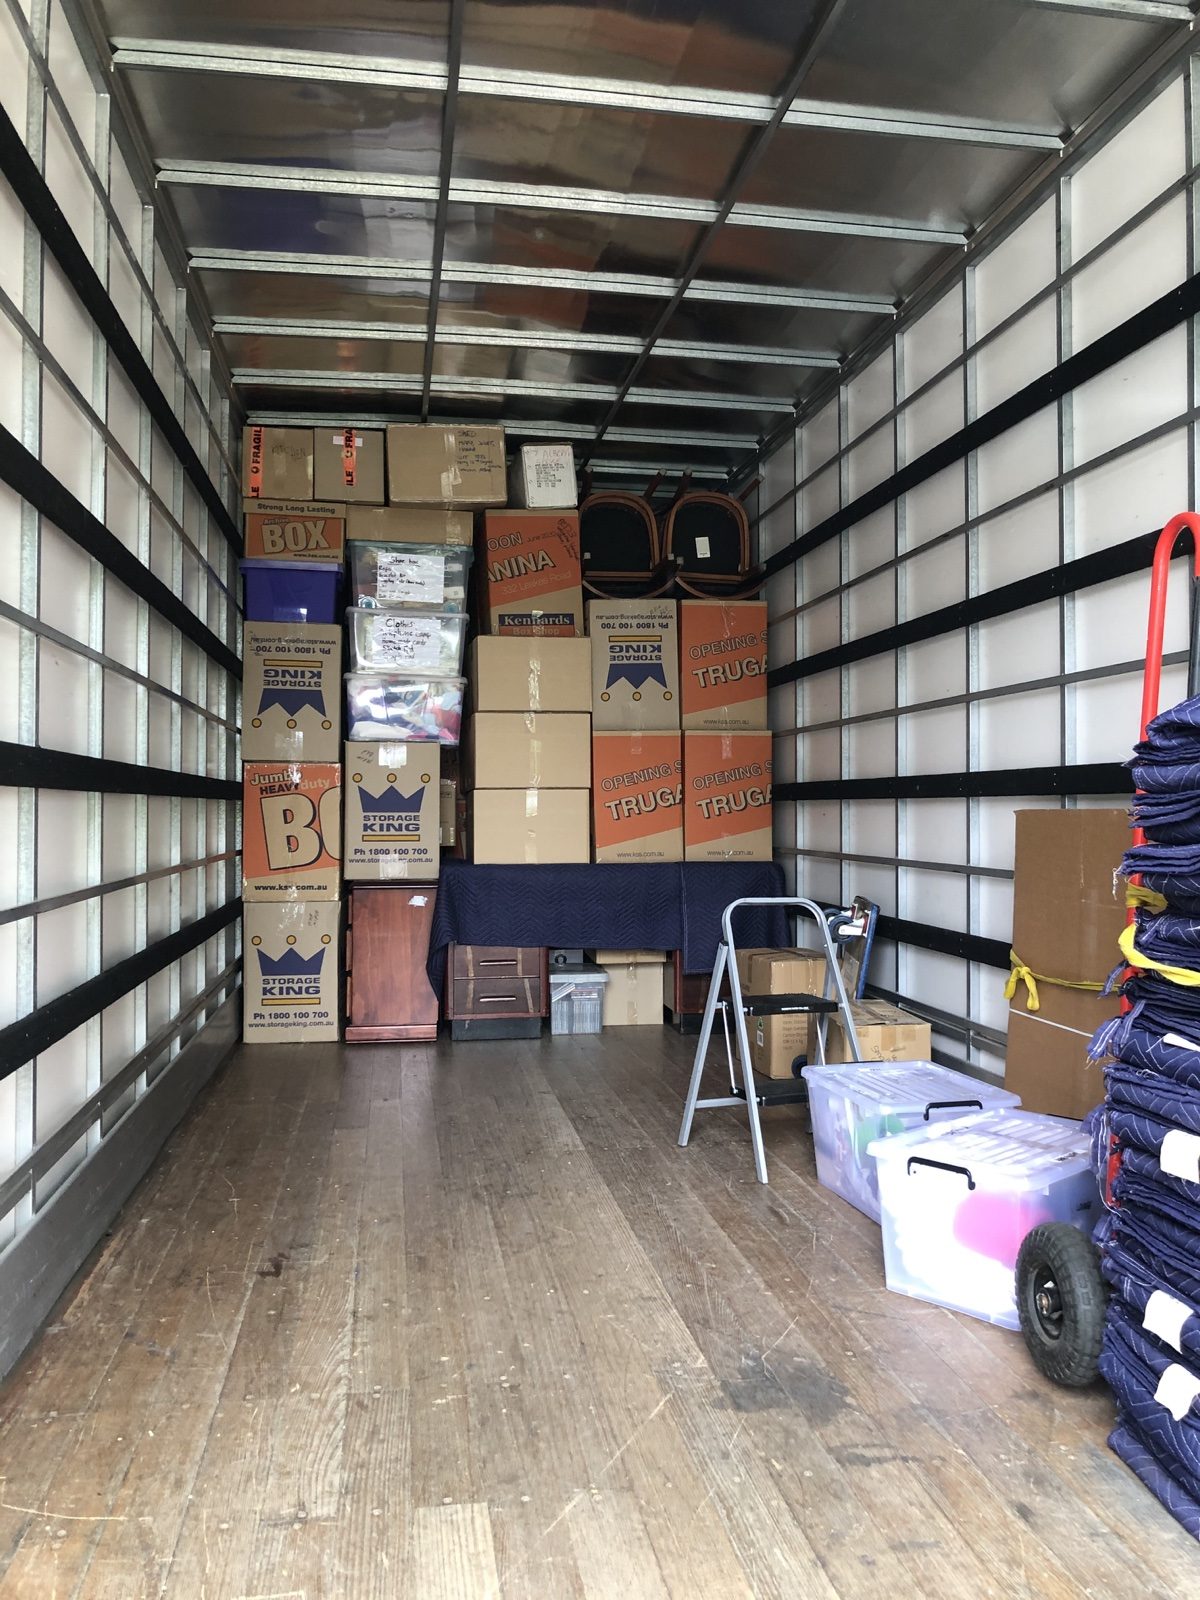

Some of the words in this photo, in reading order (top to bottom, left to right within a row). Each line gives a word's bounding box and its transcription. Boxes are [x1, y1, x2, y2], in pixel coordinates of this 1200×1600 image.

[257, 503, 284, 511] Strong
[285, 504, 305, 513] Long
[307, 505, 336, 514] Lasting
[261, 520, 331, 555] BOX
[487, 531, 523, 551] OON
[504, 615, 570, 626] Kennards
[513, 627, 530, 635] Box
[256, 645, 272, 653] 700
[275, 645, 291, 653] 100
[294, 646, 316, 654] 1800
[319, 647, 331, 655] Ph
[609, 644, 662, 653] KING
[689, 634, 758, 659] OPENING
[263, 669, 322, 679] KING
[263, 680, 322, 688] STORAGE
[250, 769, 301, 786] Jumb
[601, 763, 672, 792] OPENING
[692, 762, 762, 790] OPENING
[259, 782, 300, 796] HEAVY
[301, 779, 330, 790] duty
[362, 823, 420, 832] KING
[262, 977, 321, 985] STORAGE
[262, 985, 320, 996] KING
[253, 1012, 265, 1020] Ph
[248, 1020, 334, 1028] www.storageking.com.au
